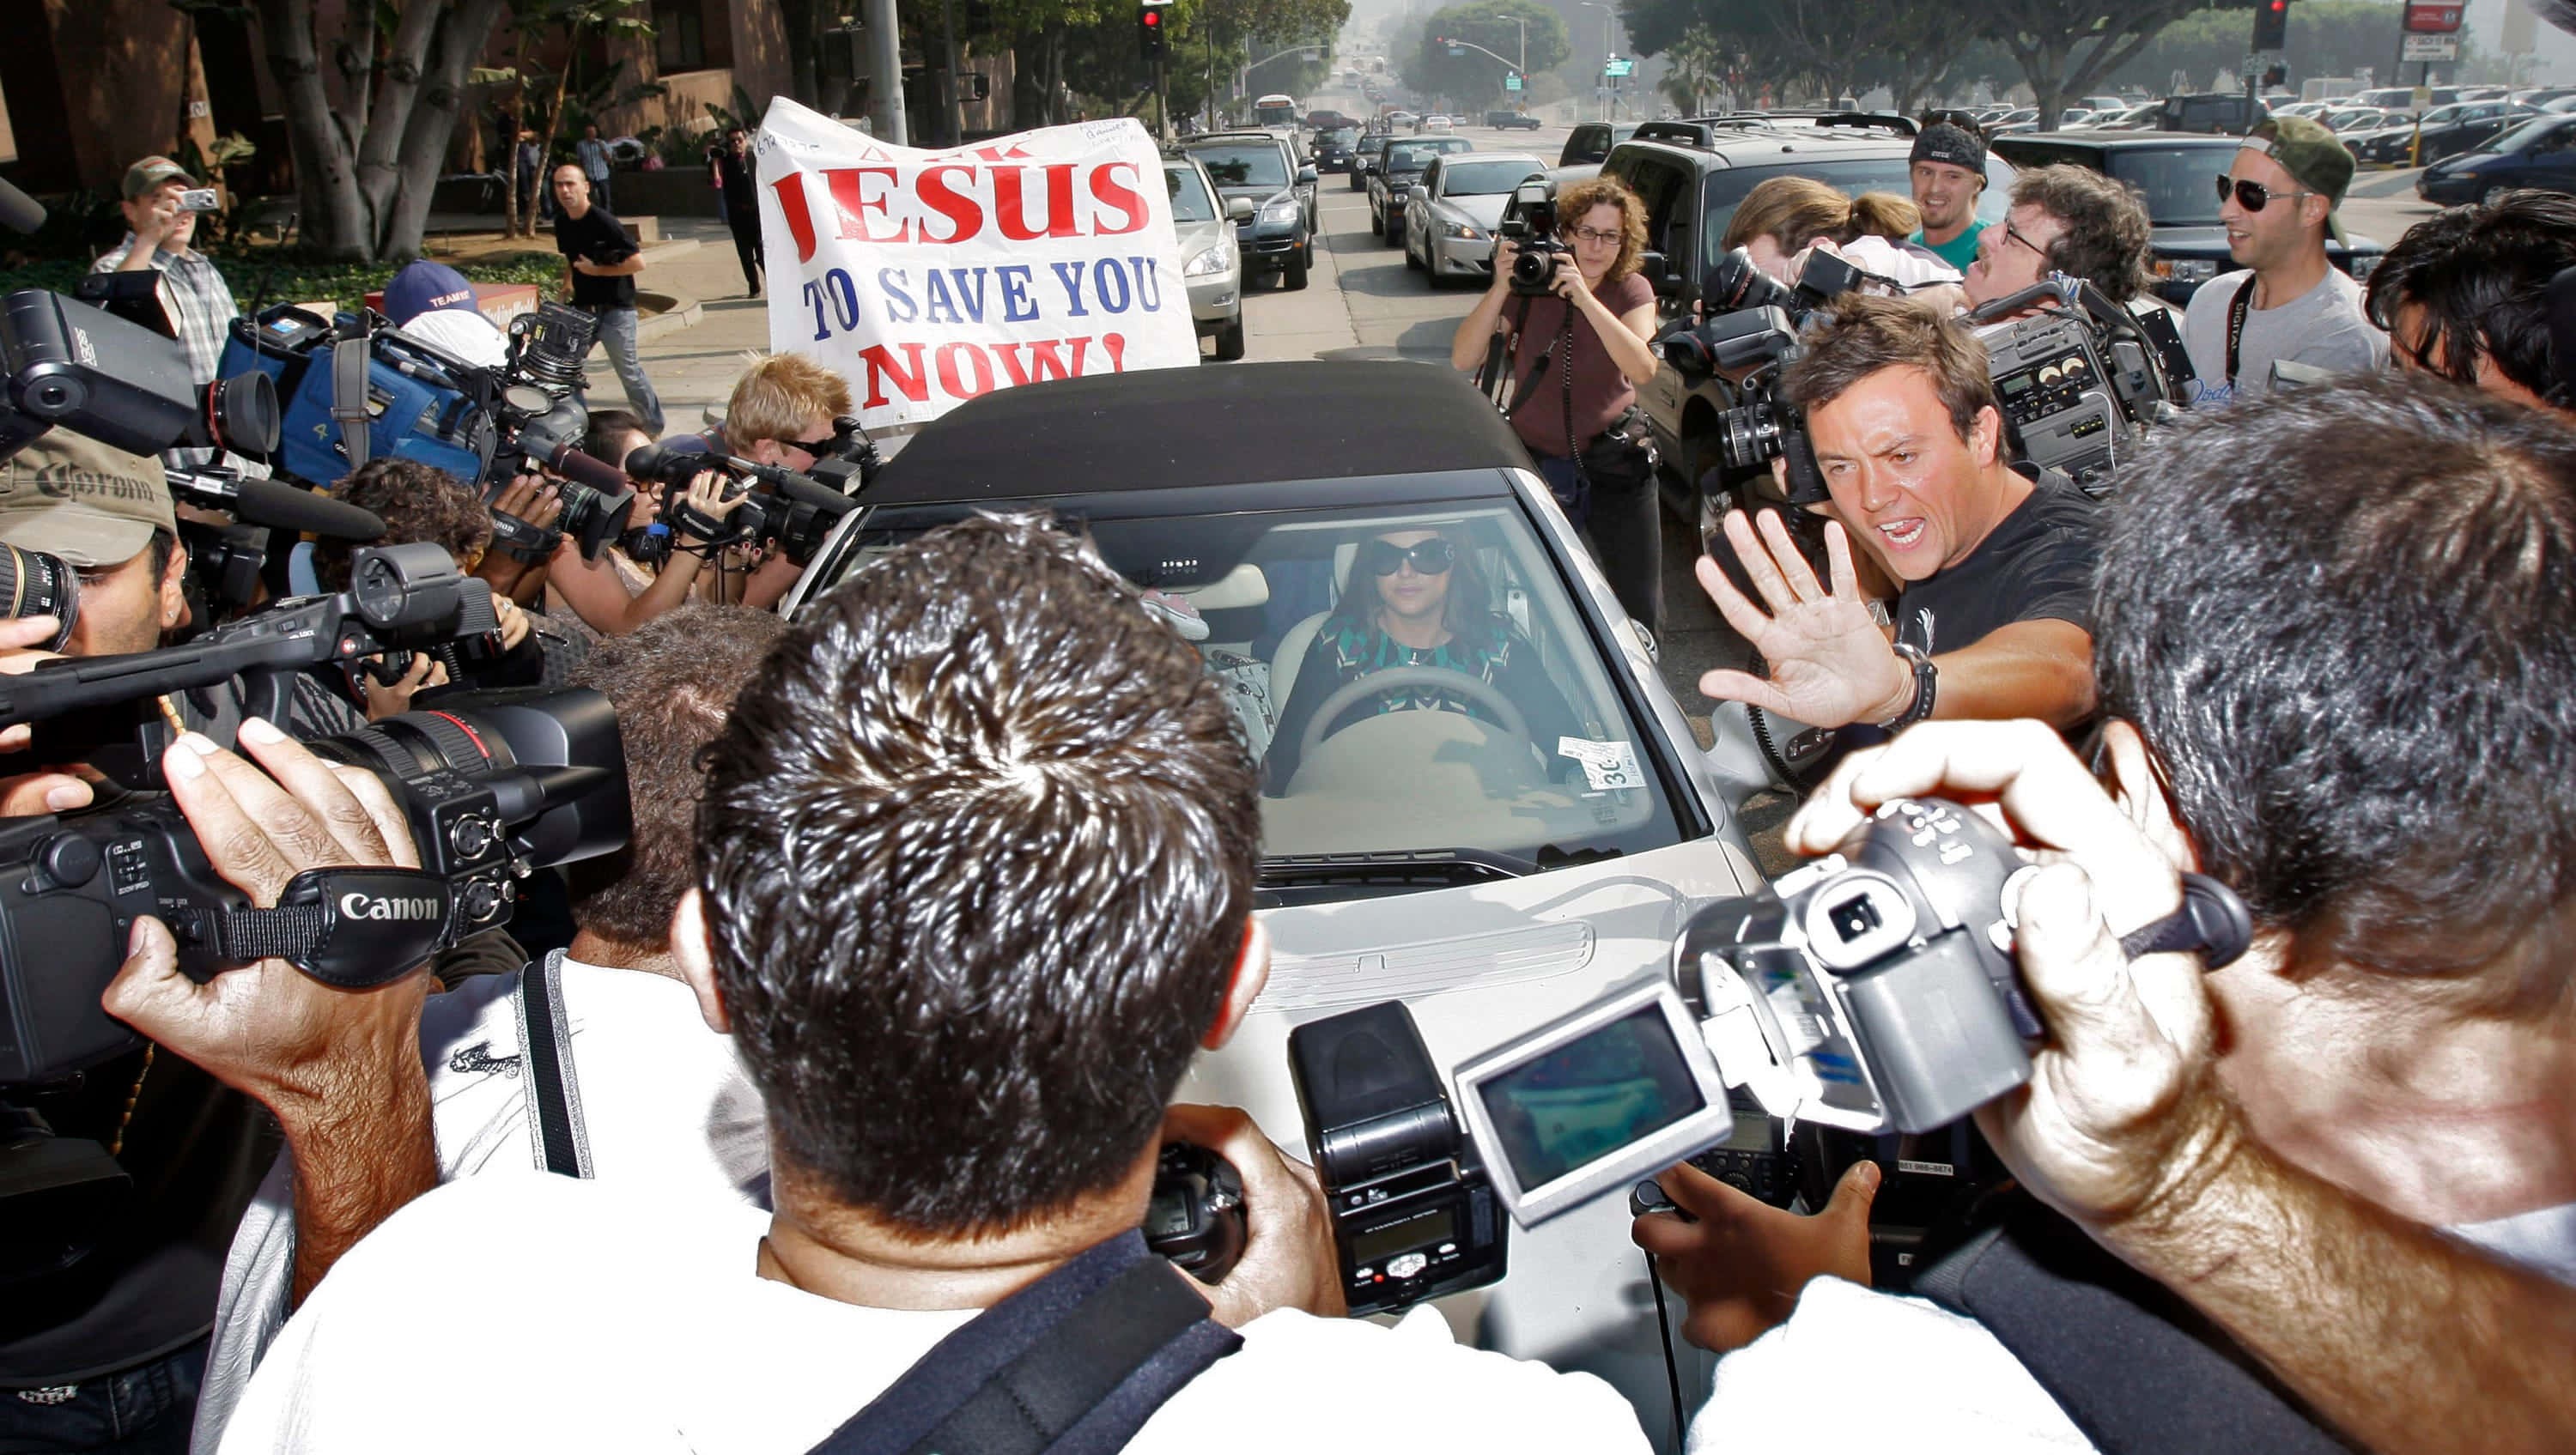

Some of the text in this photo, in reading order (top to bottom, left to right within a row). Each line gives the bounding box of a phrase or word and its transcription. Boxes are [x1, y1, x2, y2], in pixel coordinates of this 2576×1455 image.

[859, 139, 1034, 162] AK
[772, 161, 1150, 264] JESUS
[804, 258, 1162, 341] TO SAVE YOU
[858, 332, 1126, 409] NOW!
[35, 461, 155, 503] Corona
[341, 893, 439, 920] Canon
